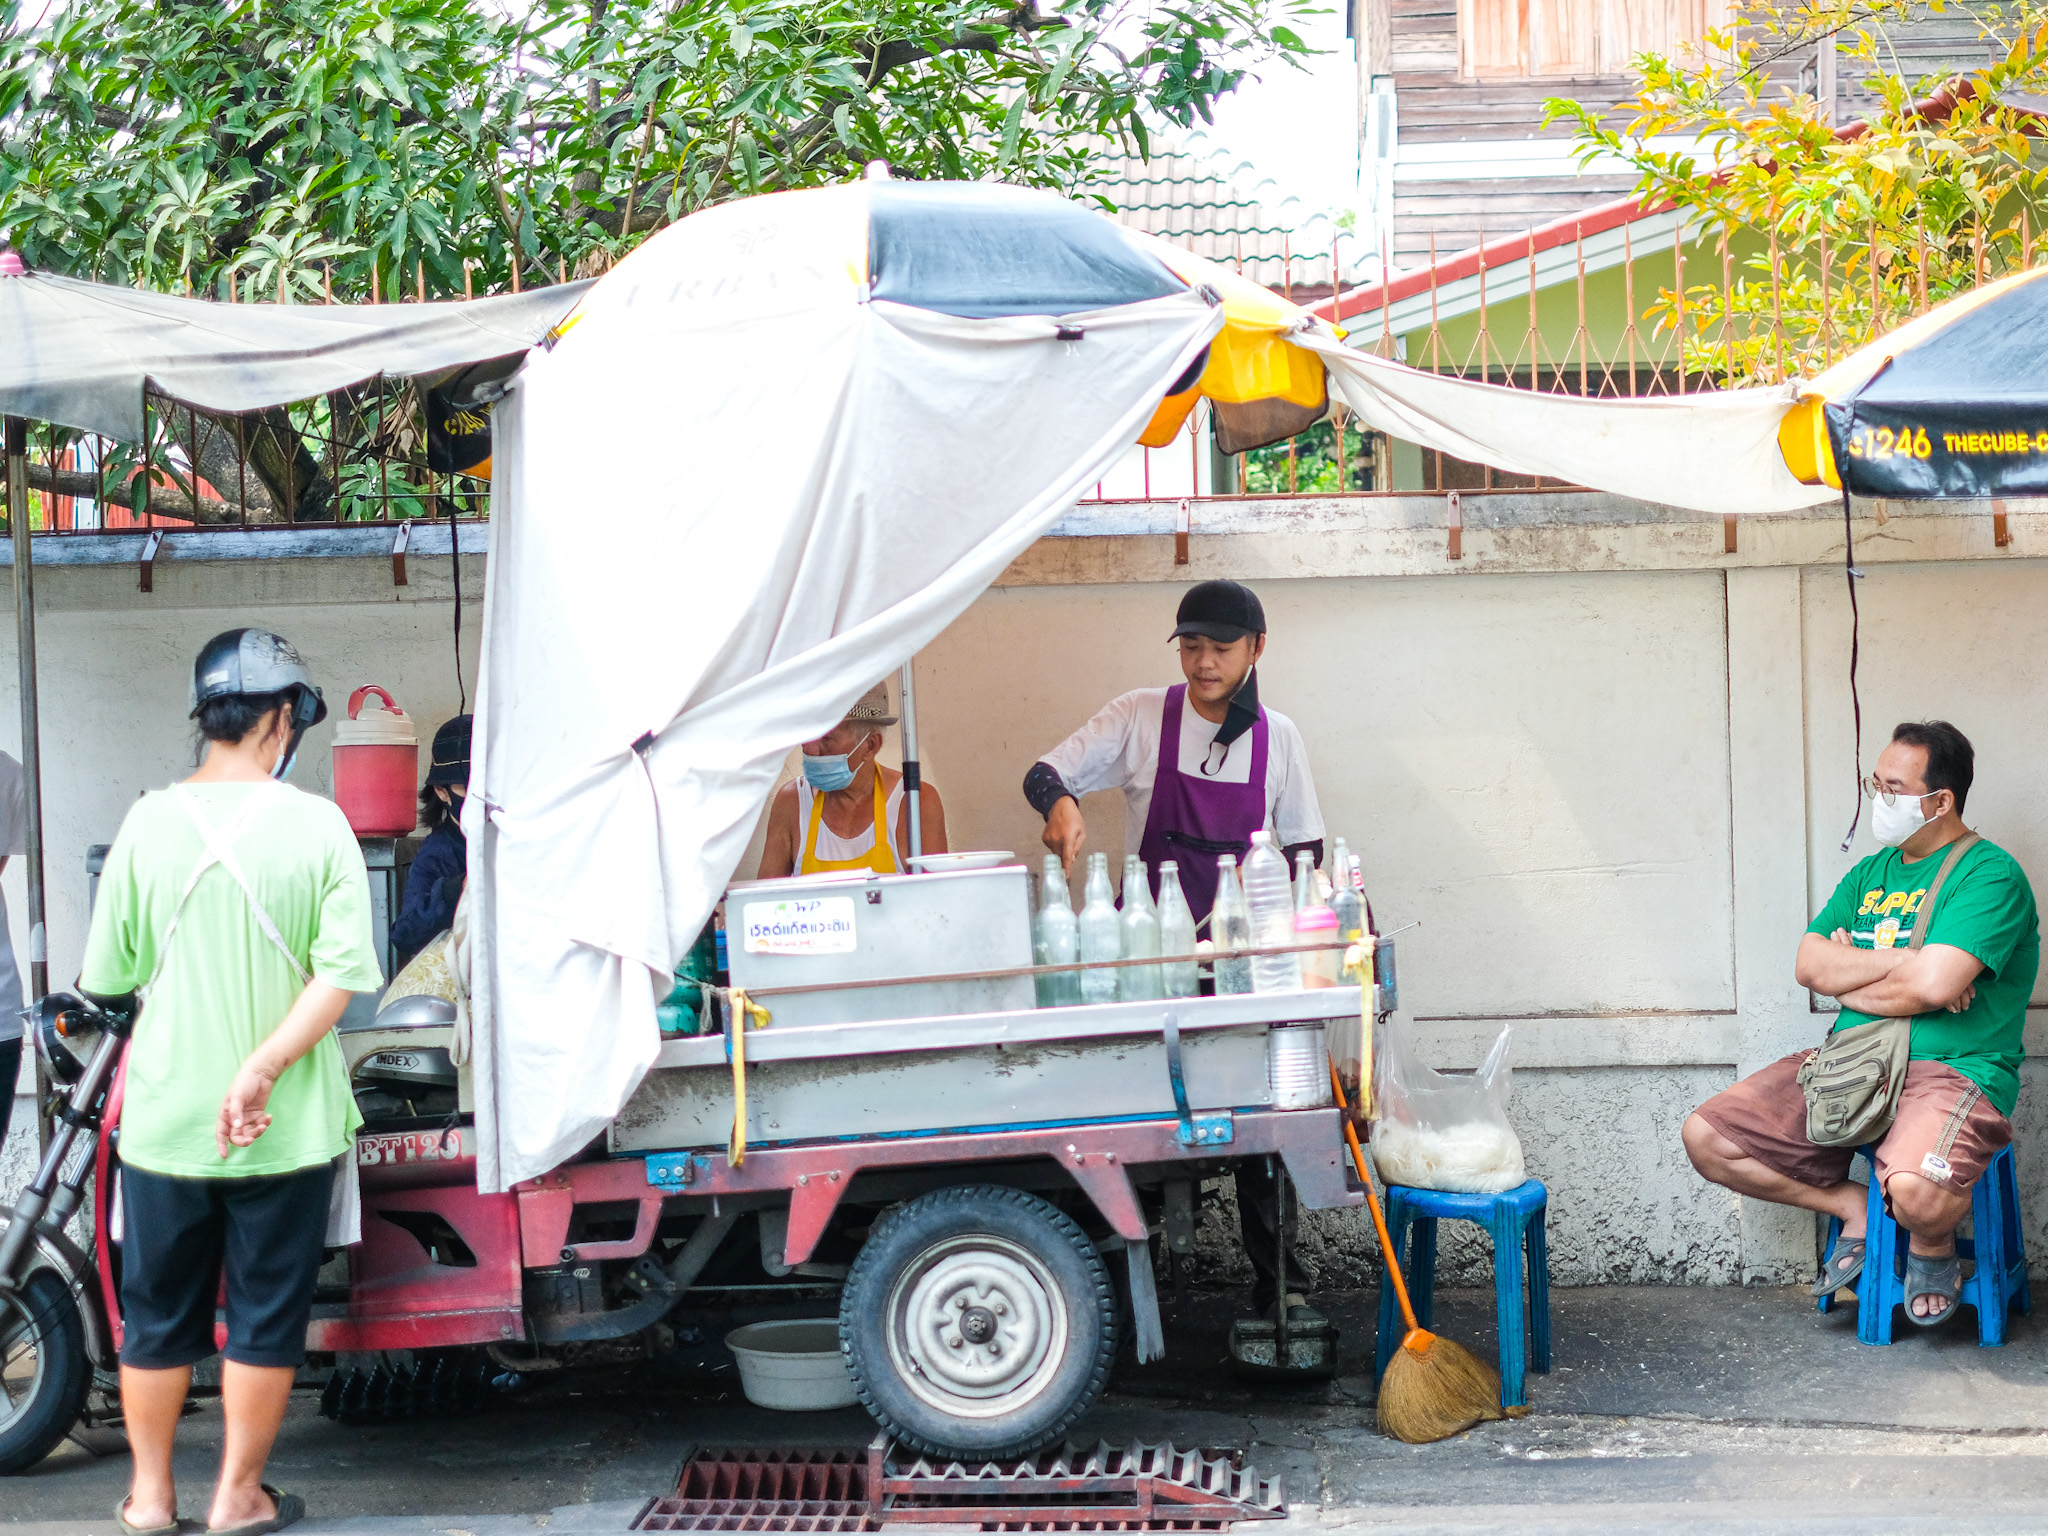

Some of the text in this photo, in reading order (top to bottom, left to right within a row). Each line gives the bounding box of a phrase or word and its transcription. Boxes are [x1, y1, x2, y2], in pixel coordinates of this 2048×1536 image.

[1865, 427, 1932, 459] 1246
[376, 1053, 412, 1067] INDEX
[358, 1133, 460, 1166] BT120
